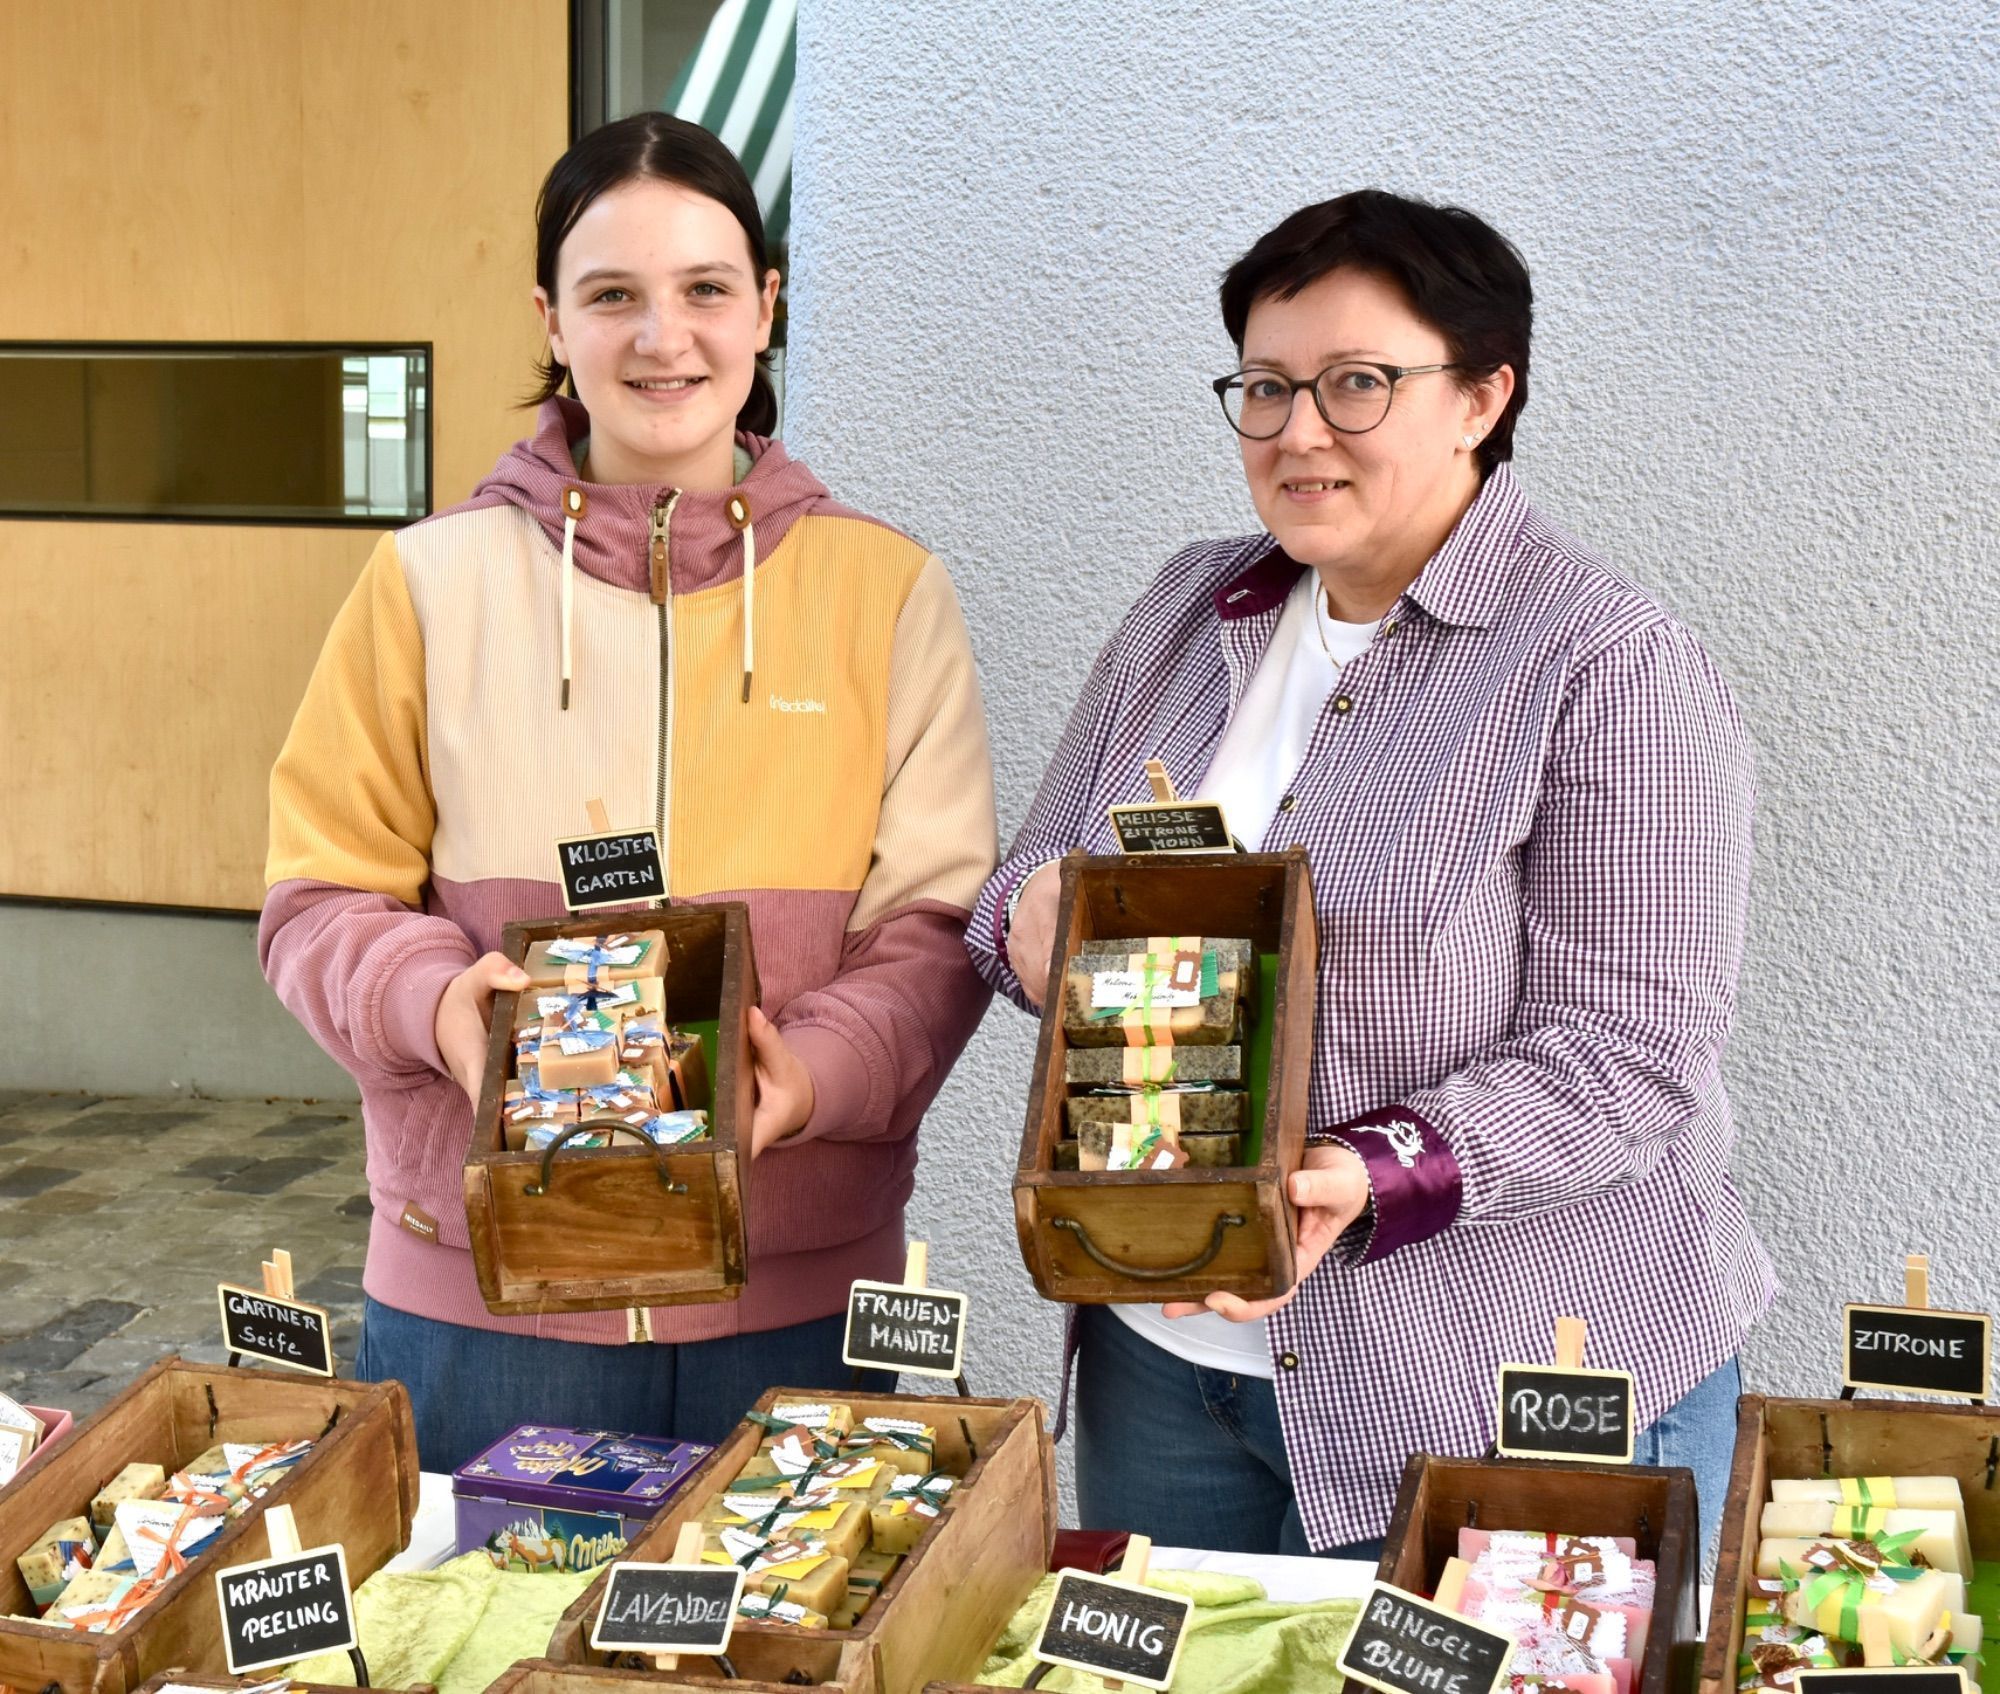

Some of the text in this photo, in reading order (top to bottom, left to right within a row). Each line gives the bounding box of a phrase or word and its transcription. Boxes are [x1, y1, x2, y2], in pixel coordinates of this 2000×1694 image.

[1116, 811, 1207, 826] MELISSE-
[567, 836, 657, 866] KLOSTER
[1150, 835, 1205, 851] MOHN
[575, 865, 655, 894] GARTEN
[228, 1293, 318, 1331] GÄRTNER
[854, 1293, 960, 1326] FRAUEN-
[238, 1326, 302, 1355] Seife
[870, 1322, 954, 1354] MANTEL
[1854, 1330, 1966, 1358] ZITRONE
[1510, 1388, 1622, 1435] ROSE
[228, 1563, 331, 1607] KRÄUTER
[241, 1601, 339, 1644] PEELING
[606, 1590, 728, 1627] LAVENDEL
[1060, 1601, 1165, 1656] HONIG
[1371, 1597, 1490, 1661] RINGEL-
[1362, 1640, 1469, 1694] BLUME
